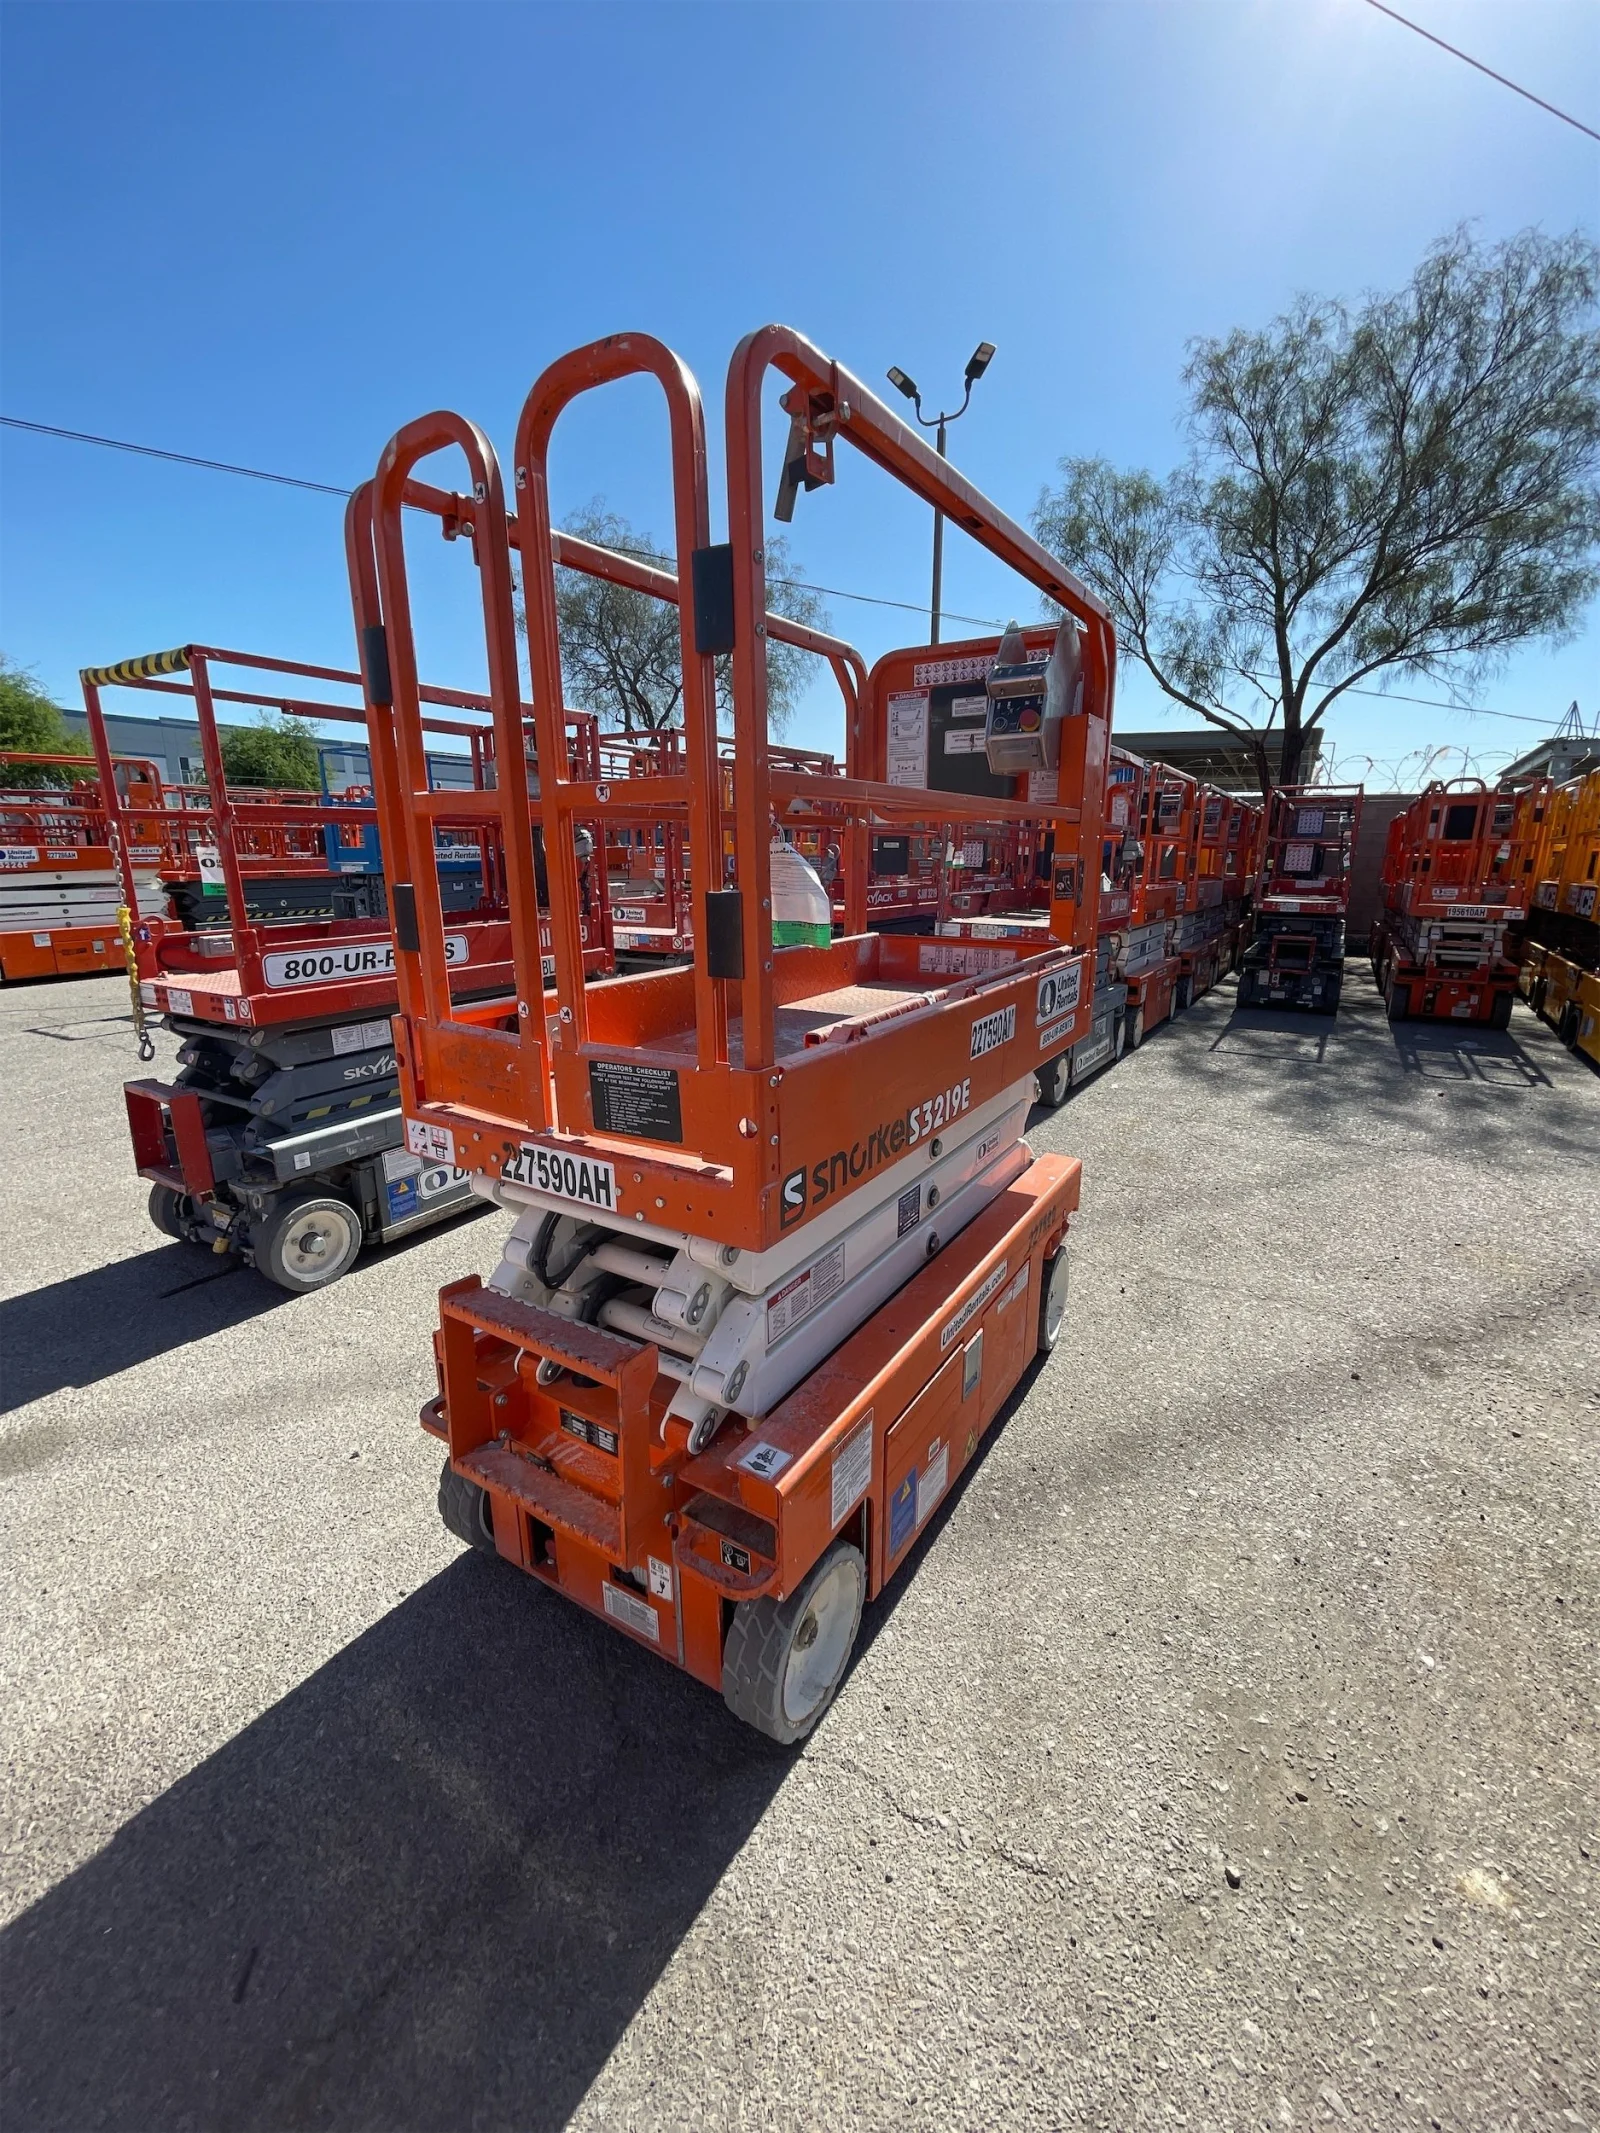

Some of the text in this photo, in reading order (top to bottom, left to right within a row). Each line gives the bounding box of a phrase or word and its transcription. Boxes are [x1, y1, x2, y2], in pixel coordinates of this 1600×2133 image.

[454, 851, 480, 859] Rentals
[284, 942, 455, 981] 800-UR-RS
[1057, 969, 1080, 993] United
[1056, 989, 1079, 1010] Rentals
[344, 1055, 398, 1081] SKYJA
[597, 1063, 671, 1077] OPERATORS CHECKLIST
[907, 1077, 971, 1146] S3219E
[942, 1265, 1007, 1347] UnitedRentals.com
